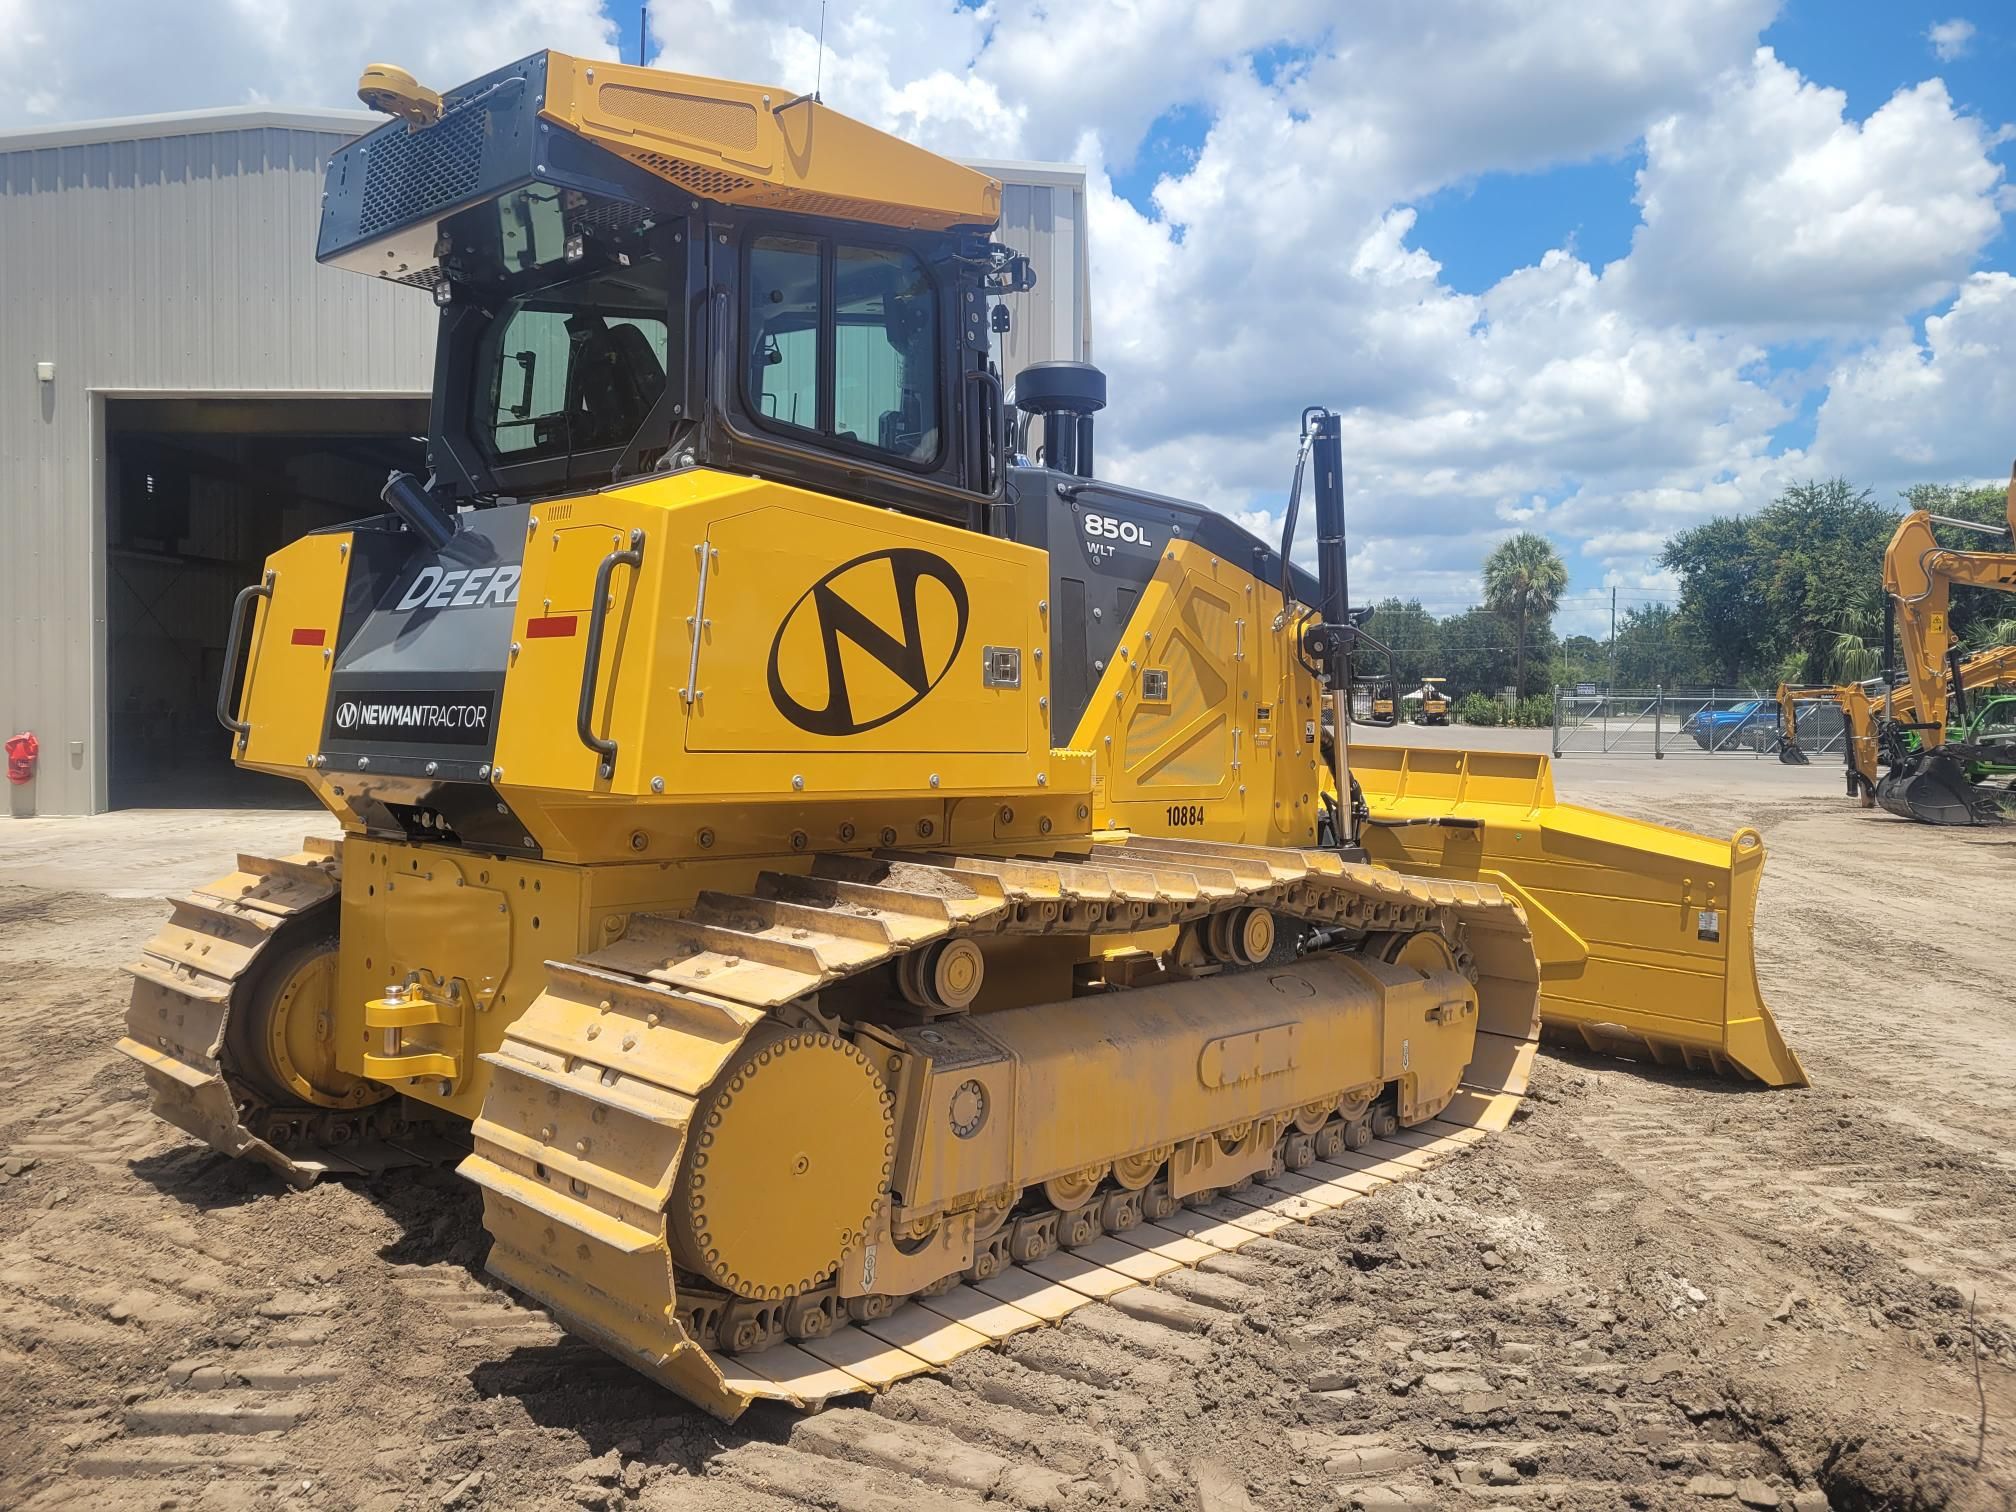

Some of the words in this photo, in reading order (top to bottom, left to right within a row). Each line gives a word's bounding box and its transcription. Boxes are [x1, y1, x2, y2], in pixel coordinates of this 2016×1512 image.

[1084, 513, 1152, 547] 850L
[1086, 541, 1116, 557] WLT
[360, 704, 487, 728] NEWMANTRACTOR
[1166, 805, 1205, 827] 10884
